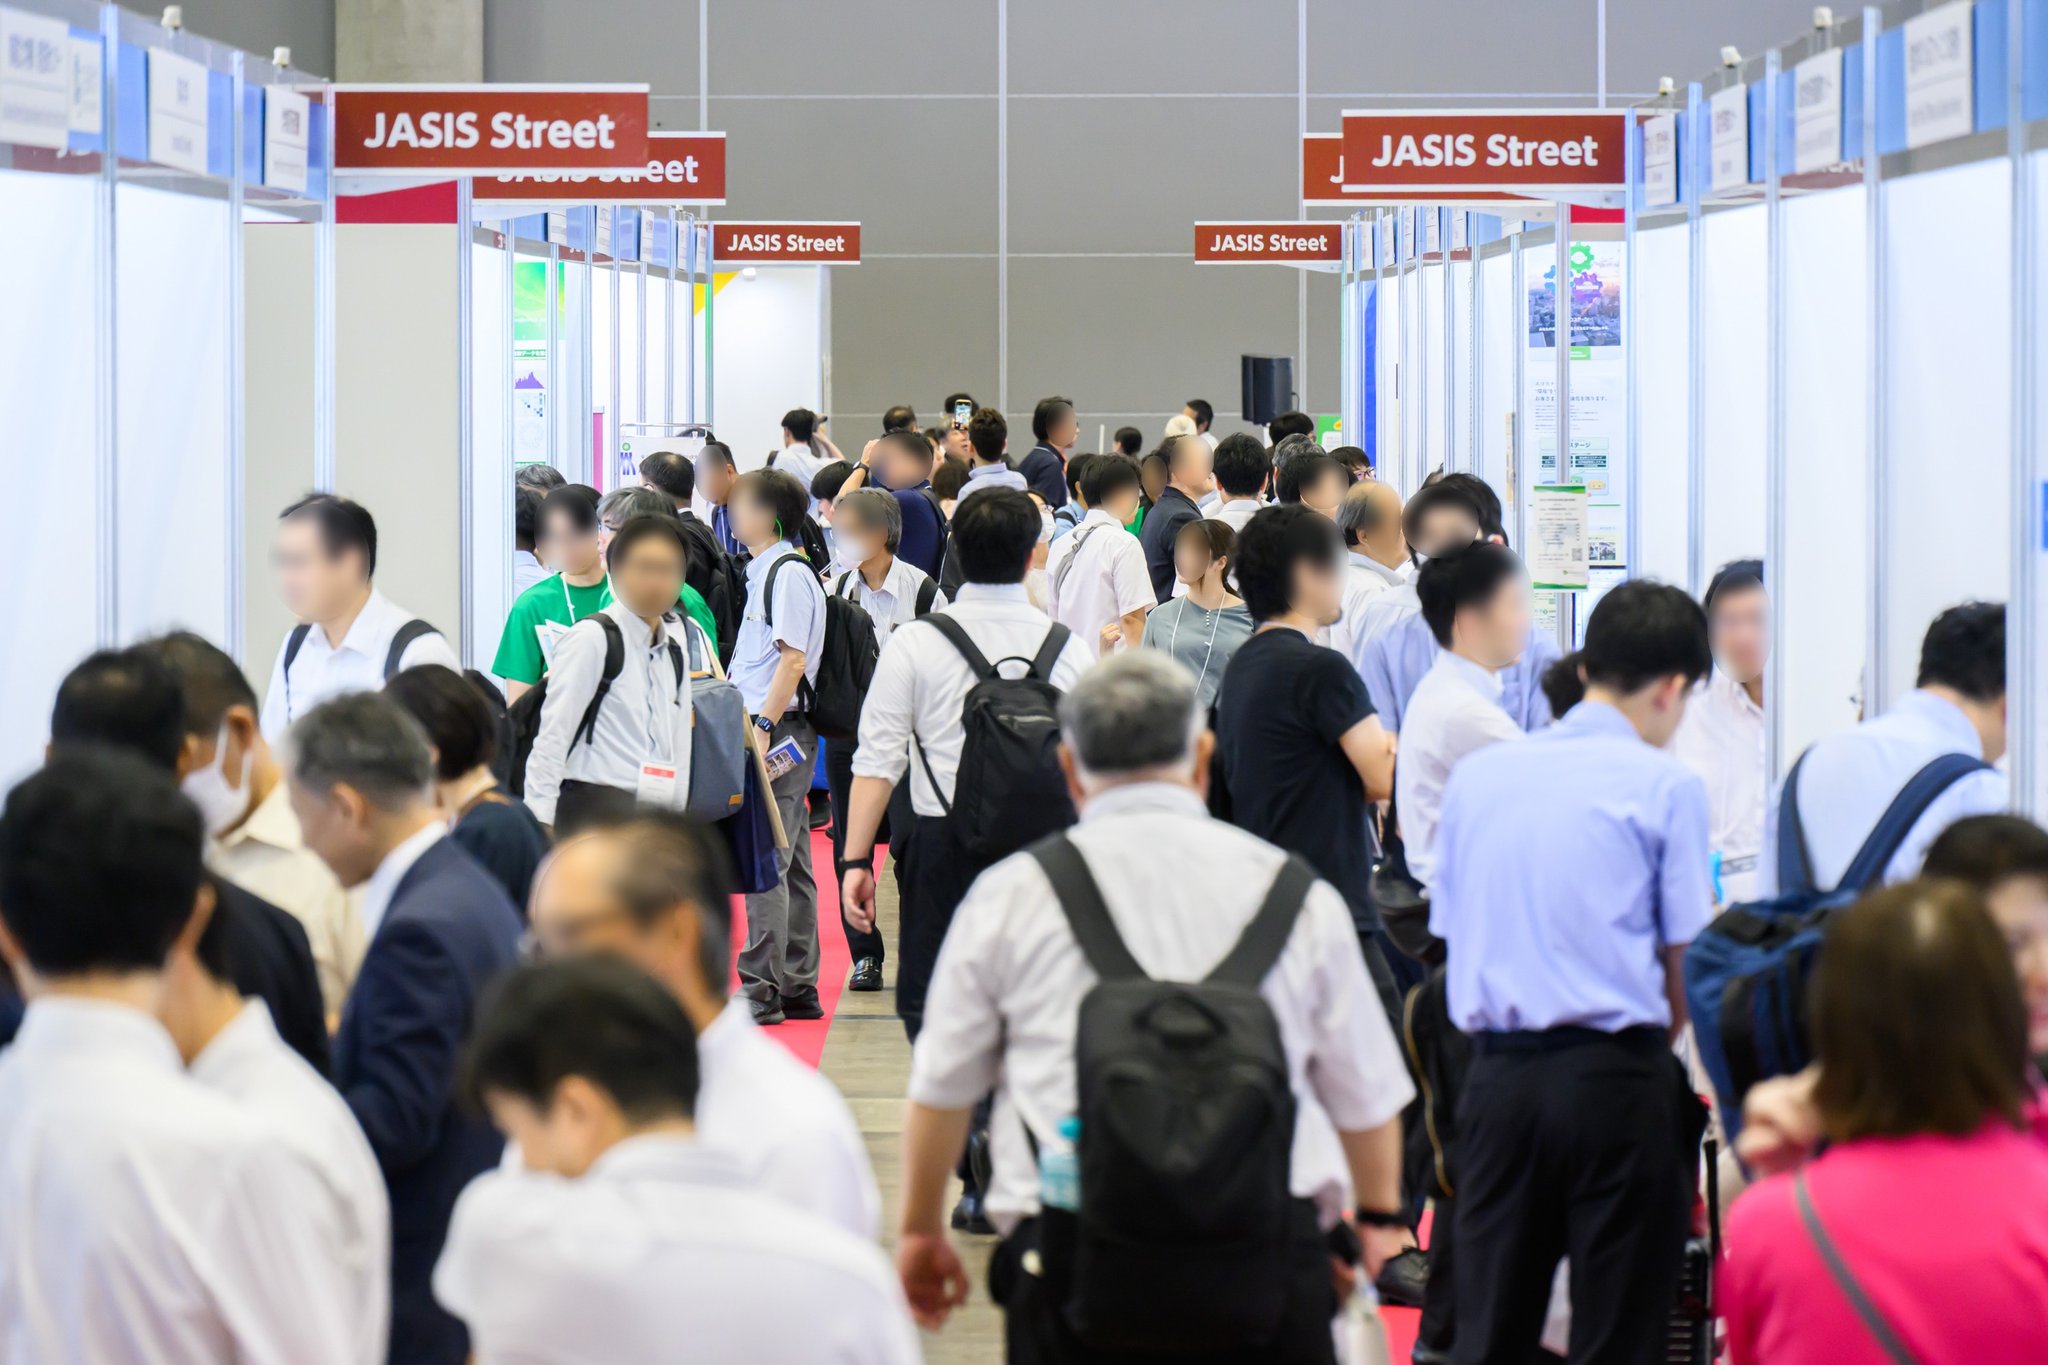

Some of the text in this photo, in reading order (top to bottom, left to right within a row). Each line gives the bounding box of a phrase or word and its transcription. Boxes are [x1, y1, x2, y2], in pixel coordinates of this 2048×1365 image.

[364, 112, 615, 149] JASIS Street
[1372, 134, 1598, 167] JASIS Street
[728, 233, 844, 252] JASIS Street
[1210, 233, 1327, 251] JASIS Street
